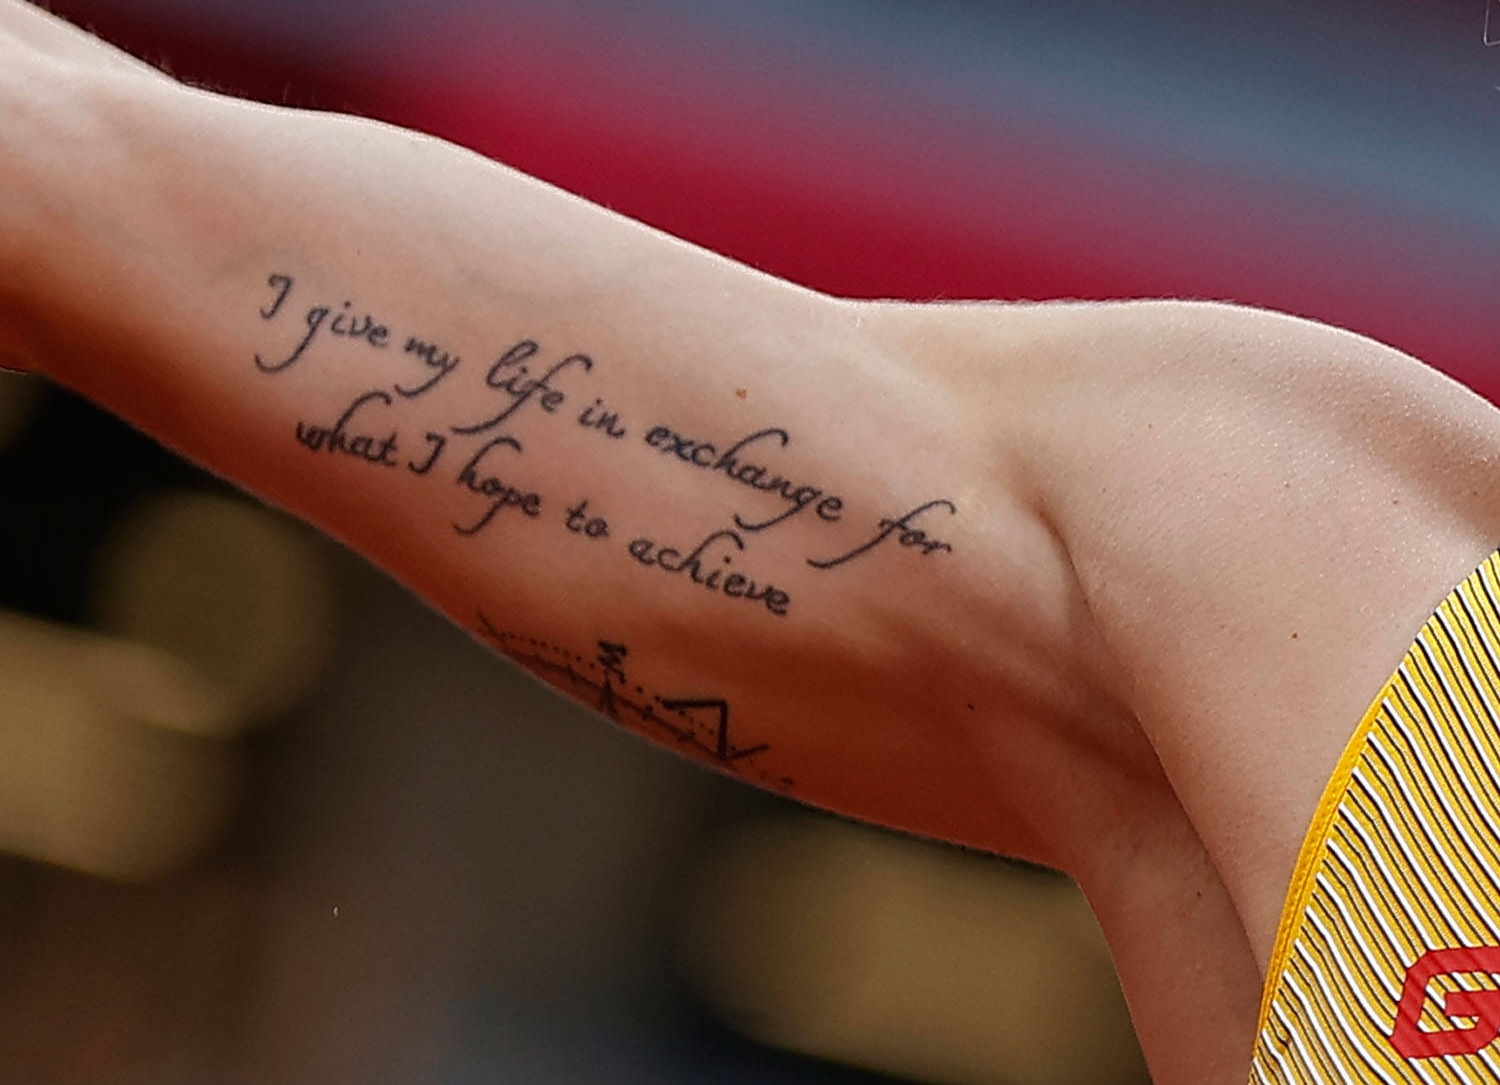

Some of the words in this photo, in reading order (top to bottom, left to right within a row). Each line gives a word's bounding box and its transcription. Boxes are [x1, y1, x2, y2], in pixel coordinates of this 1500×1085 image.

[258, 272, 295, 322] I
[253, 299, 391, 375] give
[393, 336, 461, 401] my
[449, 338, 595, 437] life
[576, 397, 627, 442] in
[294, 389, 399, 471] what
[407, 431, 448, 477] I
[452, 434, 543, 537] hope
[564, 498, 611, 541] to
[627, 528, 791, 618] achieve
[643, 425, 845, 534] exchange
[806, 498, 958, 571] for
